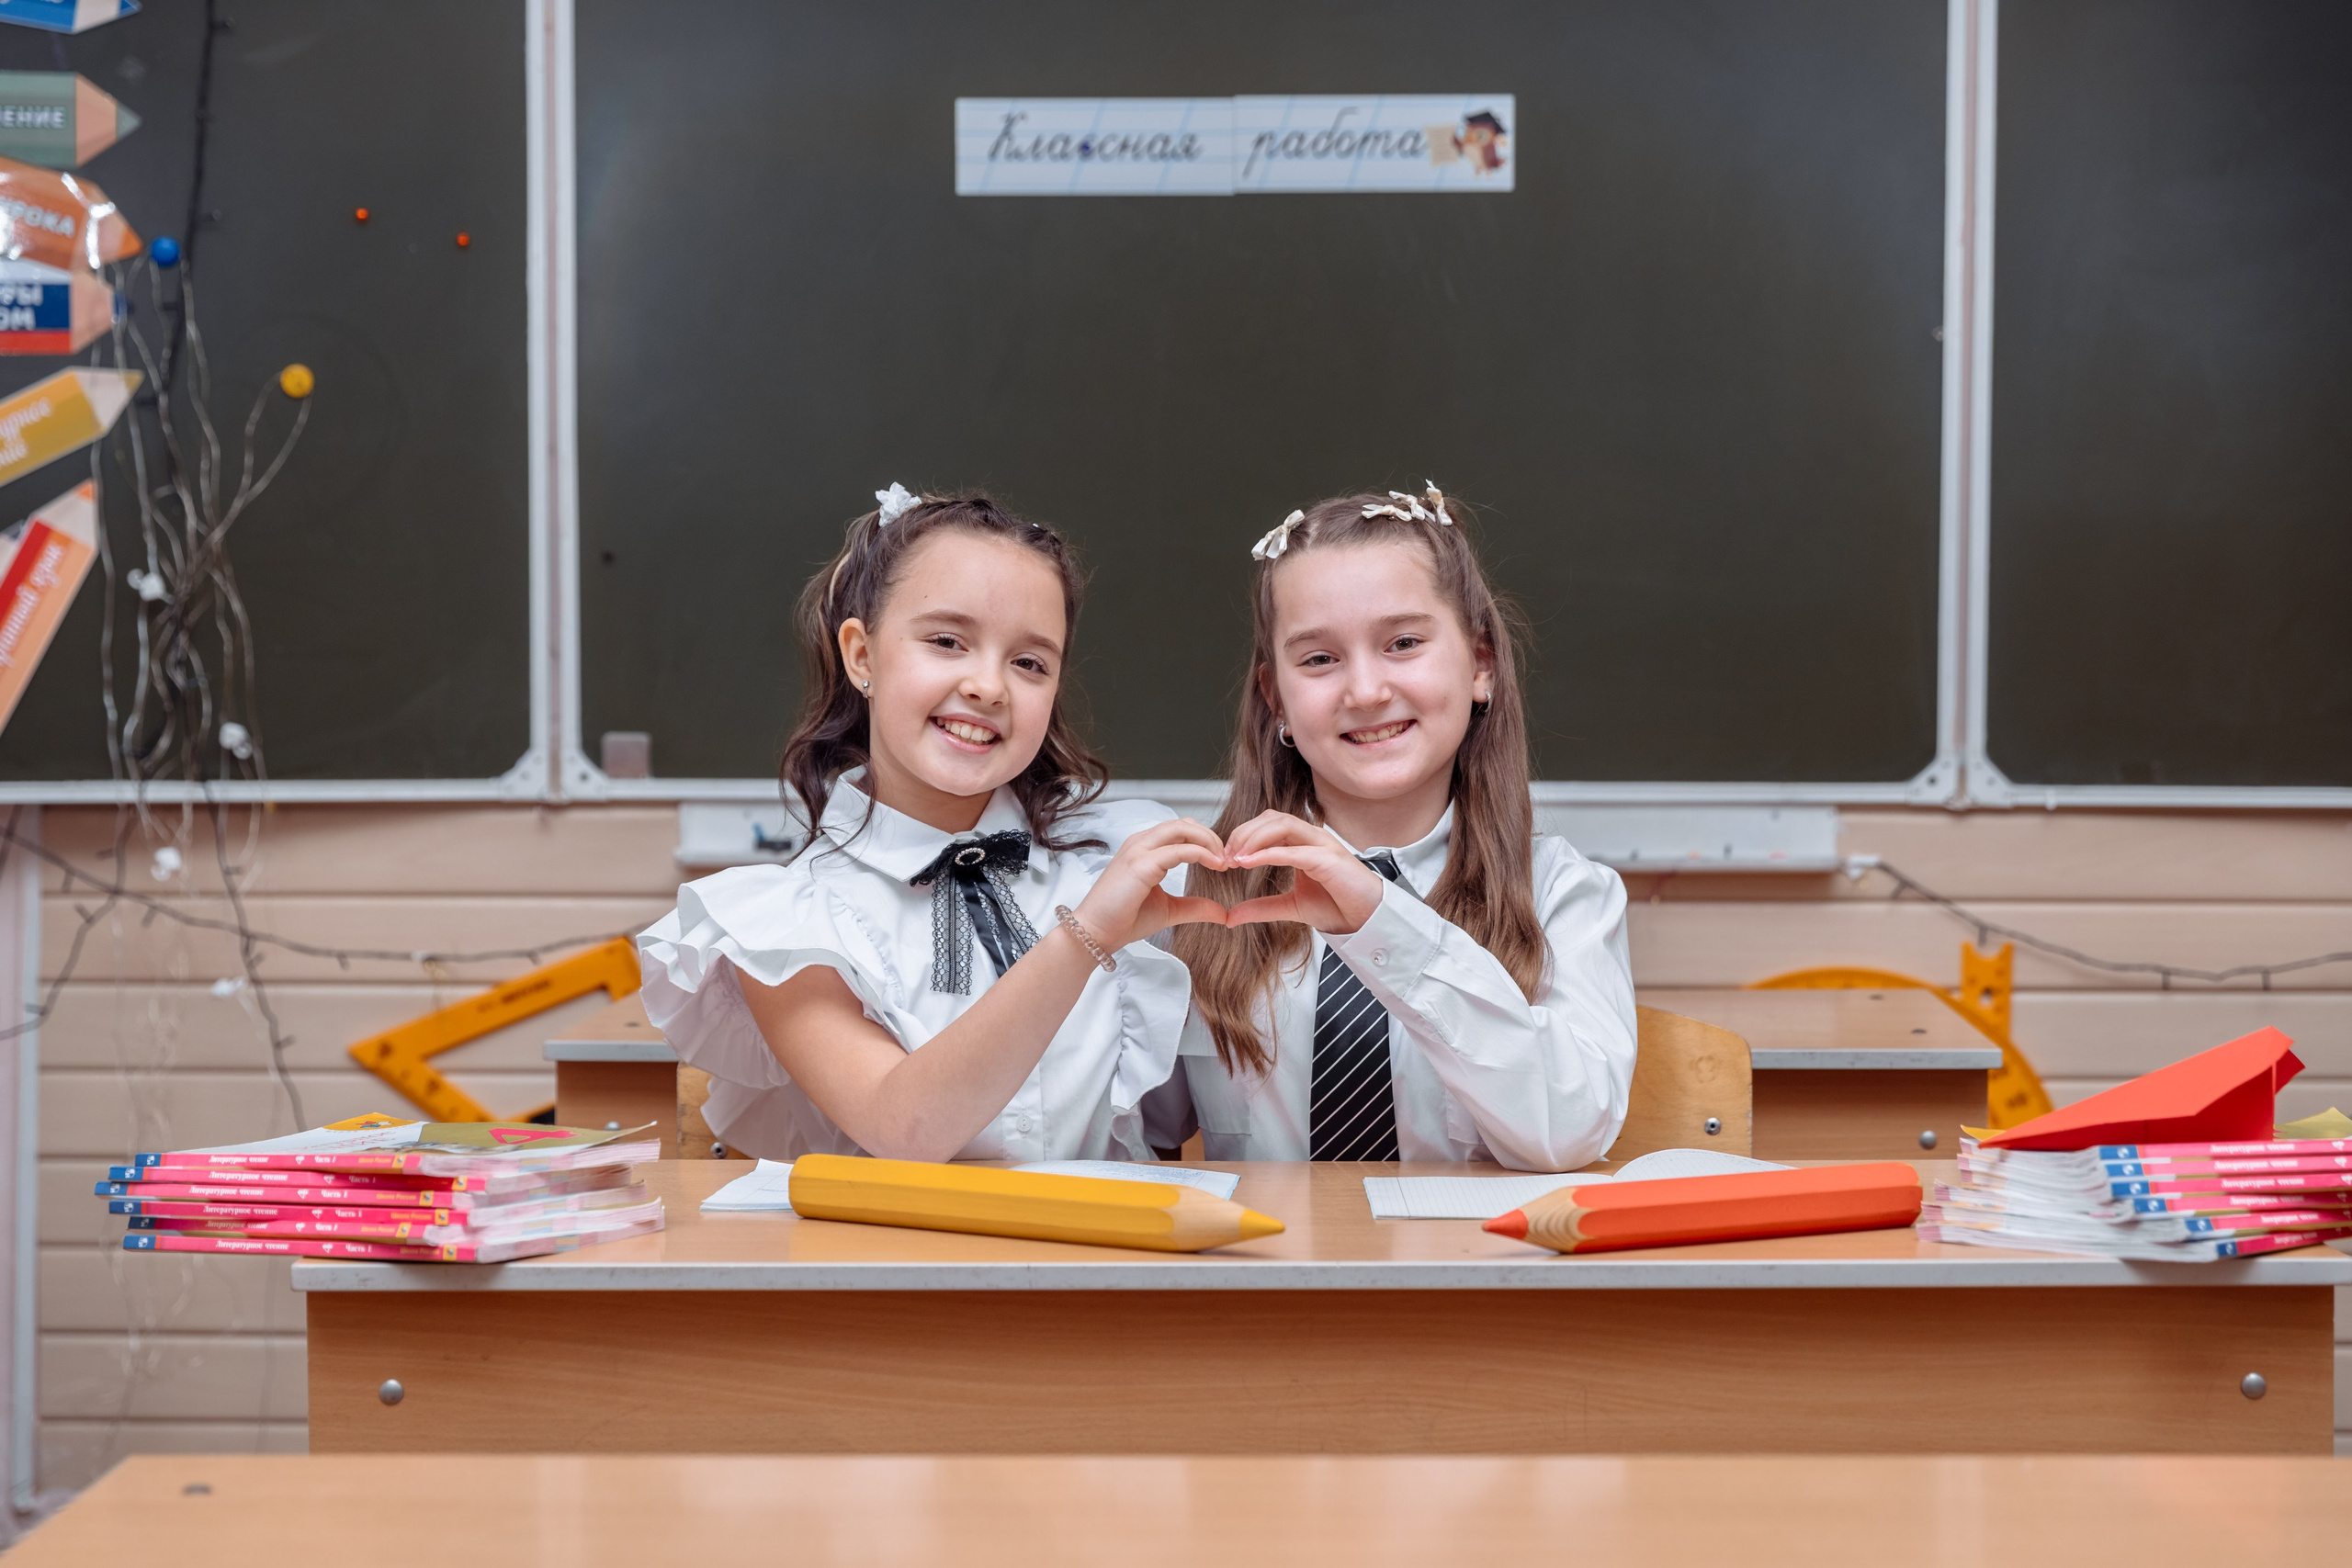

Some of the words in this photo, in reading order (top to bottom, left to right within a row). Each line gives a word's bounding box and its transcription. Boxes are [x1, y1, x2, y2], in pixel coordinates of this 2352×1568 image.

[0, 105, 66, 130] ЕНИЕ
[987, 112, 1204, 163] Классная
[1241, 106, 1427, 179] работа
[209, 1156, 248, 1165] Литературное
[209, 1171, 260, 1182] Литературное
[262, 1173, 288, 1181] чтение
[349, 1175, 369, 1184] Часть
[188, 1186, 237, 1196] Литературное
[239, 1188, 264, 1196] чтение
[321, 1190, 342, 1198] Часть
[203, 1205, 251, 1215] Литературное
[335, 1209, 356, 1217] Часть
[205, 1220, 245, 1229] Литературное
[315, 1223, 332, 1231] Часть
[215, 1240, 263, 1250] Литературное
[345, 1244, 366, 1252] Часть
